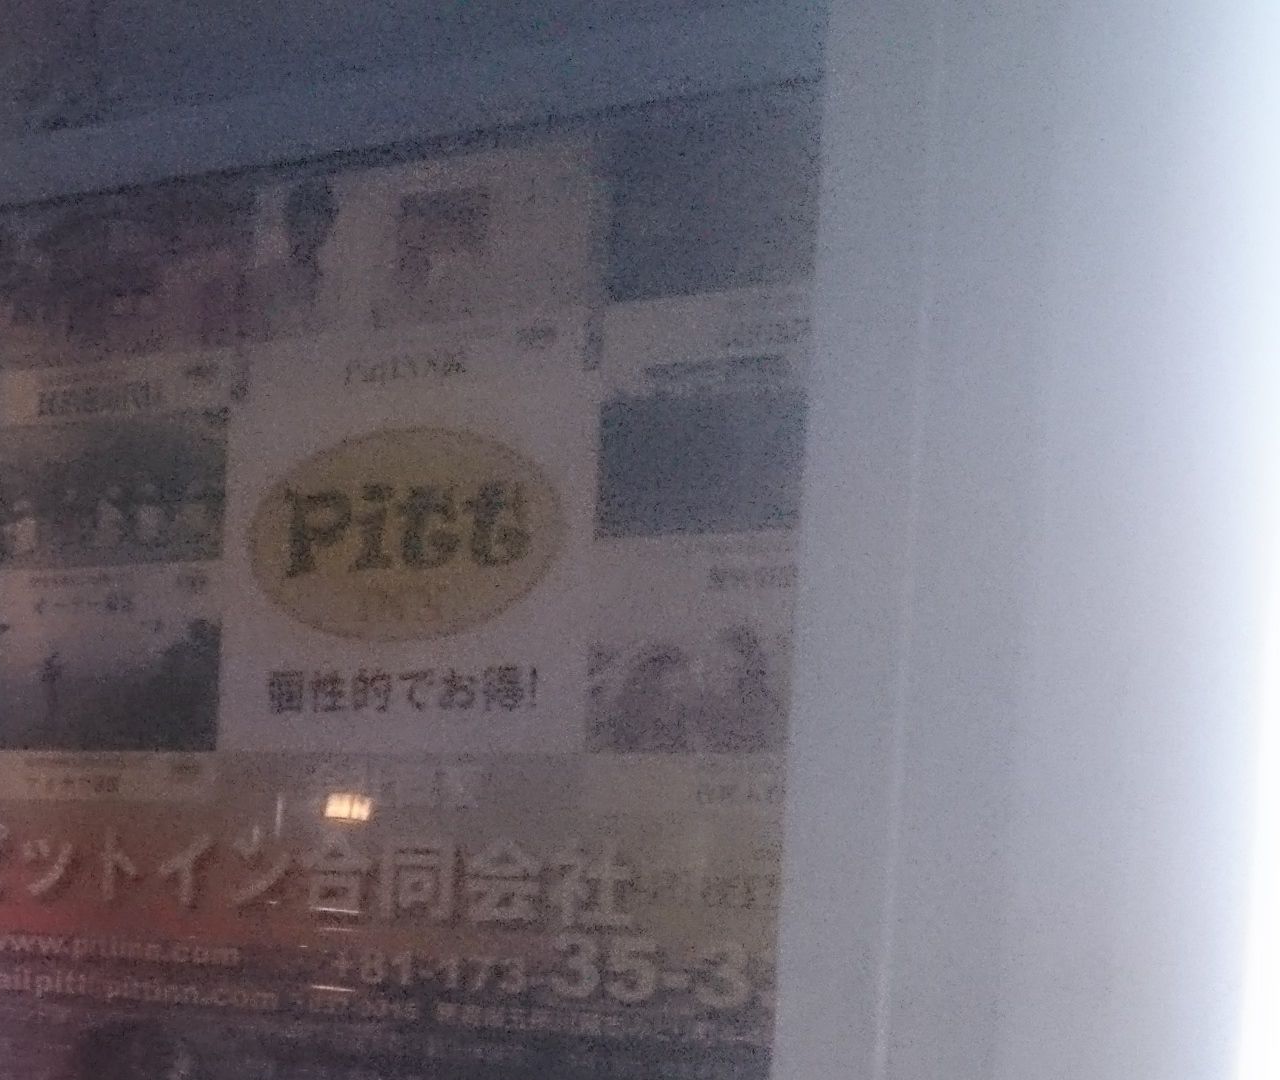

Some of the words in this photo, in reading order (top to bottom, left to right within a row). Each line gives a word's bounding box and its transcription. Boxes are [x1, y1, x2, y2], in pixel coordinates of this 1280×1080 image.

[284, 480, 532, 578] Pitt
[267, 665, 538, 714] 個性的でお得!
[332, 932, 775, 1009] +81-173-35-3
